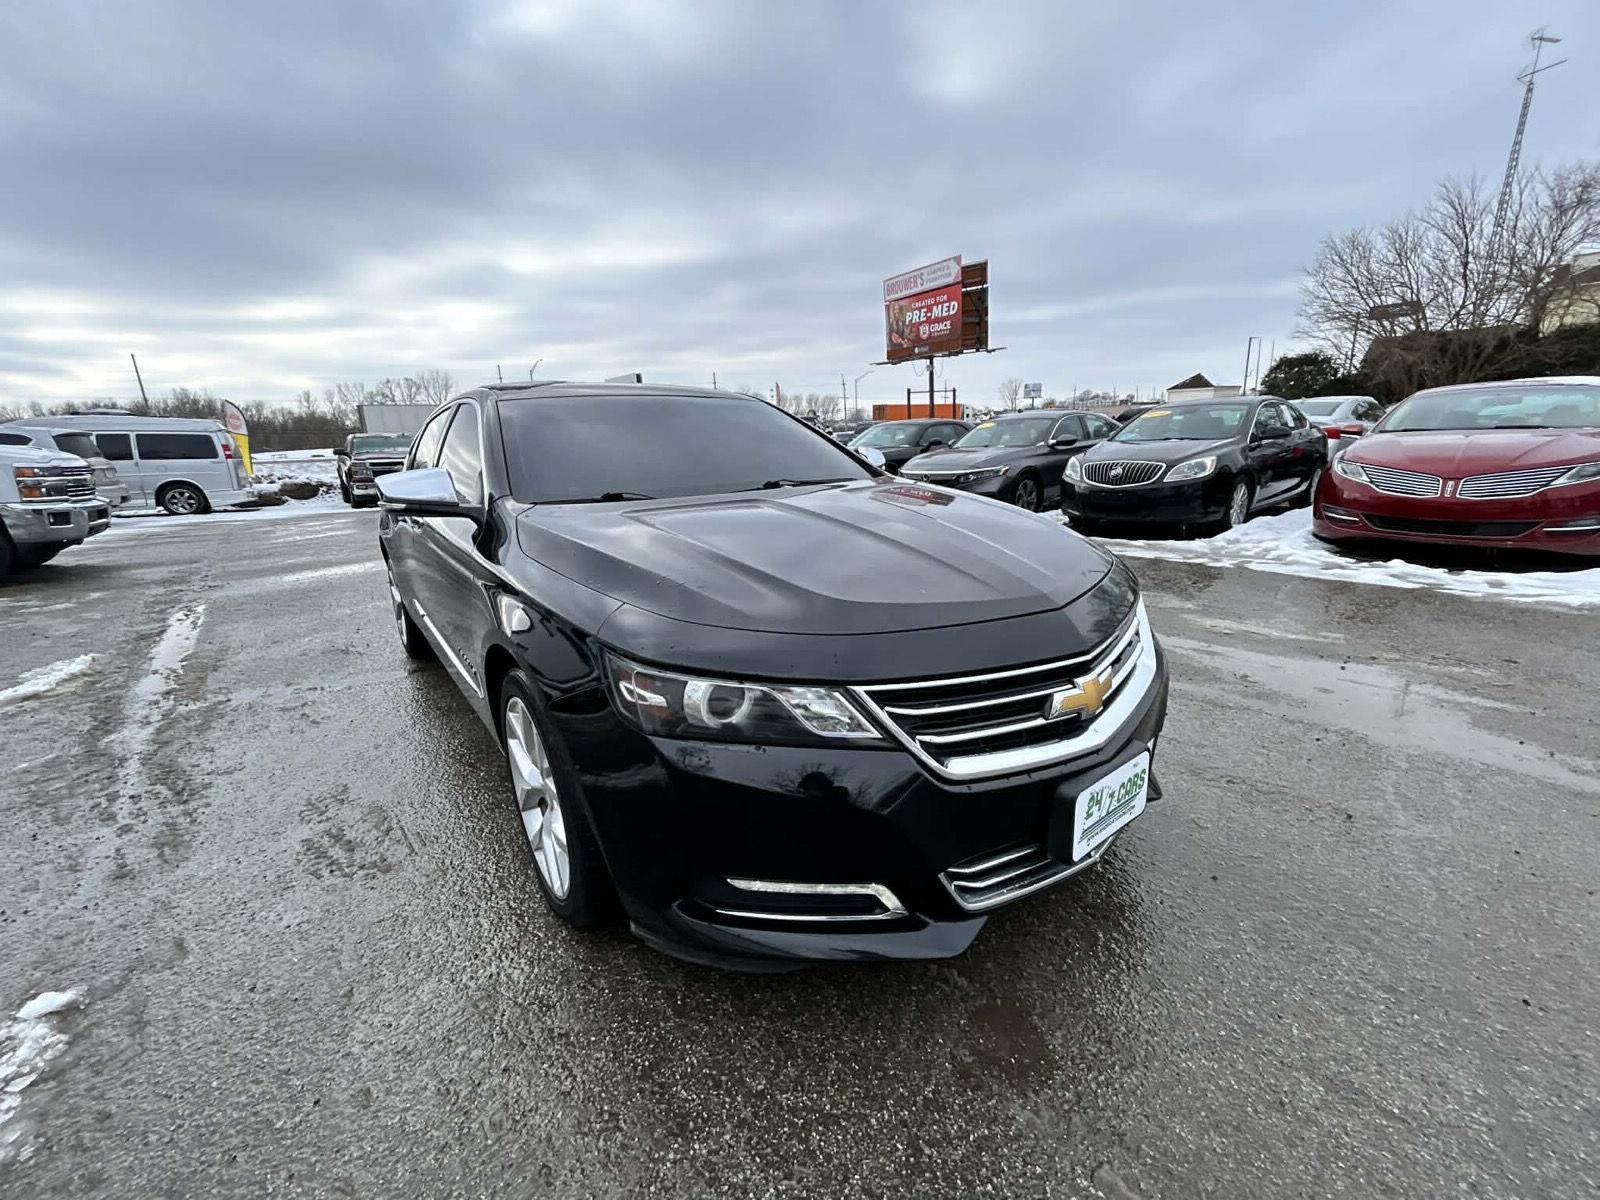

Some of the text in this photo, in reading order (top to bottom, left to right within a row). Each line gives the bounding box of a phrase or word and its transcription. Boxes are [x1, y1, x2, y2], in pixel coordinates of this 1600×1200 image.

[886, 272, 925, 296] BROUWER'S
[905, 301, 958, 325] PRE-MED
[911, 294, 948, 309] CREATED FOR
[930, 320, 952, 332] GRACE
[1116, 768, 1147, 804] CARS
